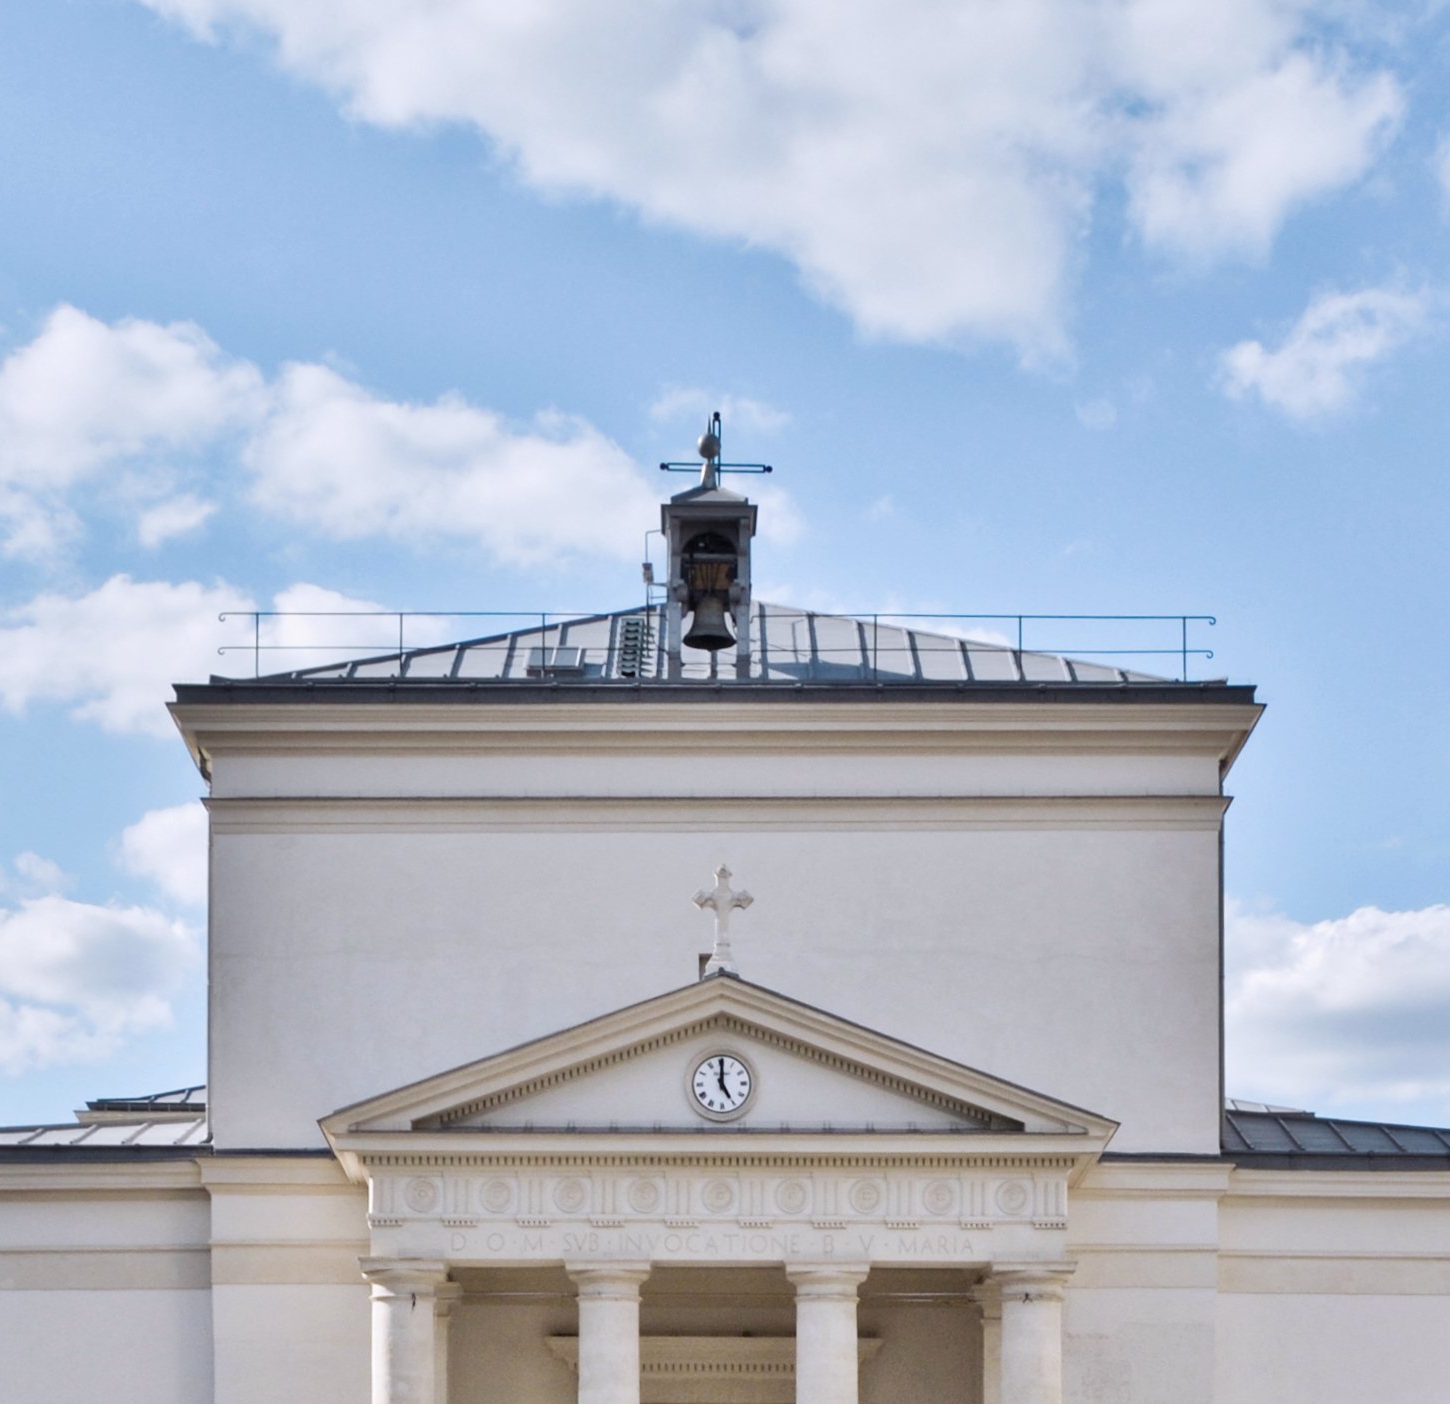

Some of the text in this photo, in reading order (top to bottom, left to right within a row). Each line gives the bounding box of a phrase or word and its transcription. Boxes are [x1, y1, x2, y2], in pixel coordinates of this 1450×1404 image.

[450, 1232, 467, 1252] D
[486, 1232, 505, 1252] O
[523, 1233, 543, 1252] M
[618, 1233, 801, 1255] INVOCATIONE
[823, 1234, 835, 1254] B
[858, 1234, 875, 1254] V
[898, 1234, 974, 1255] MARIA
